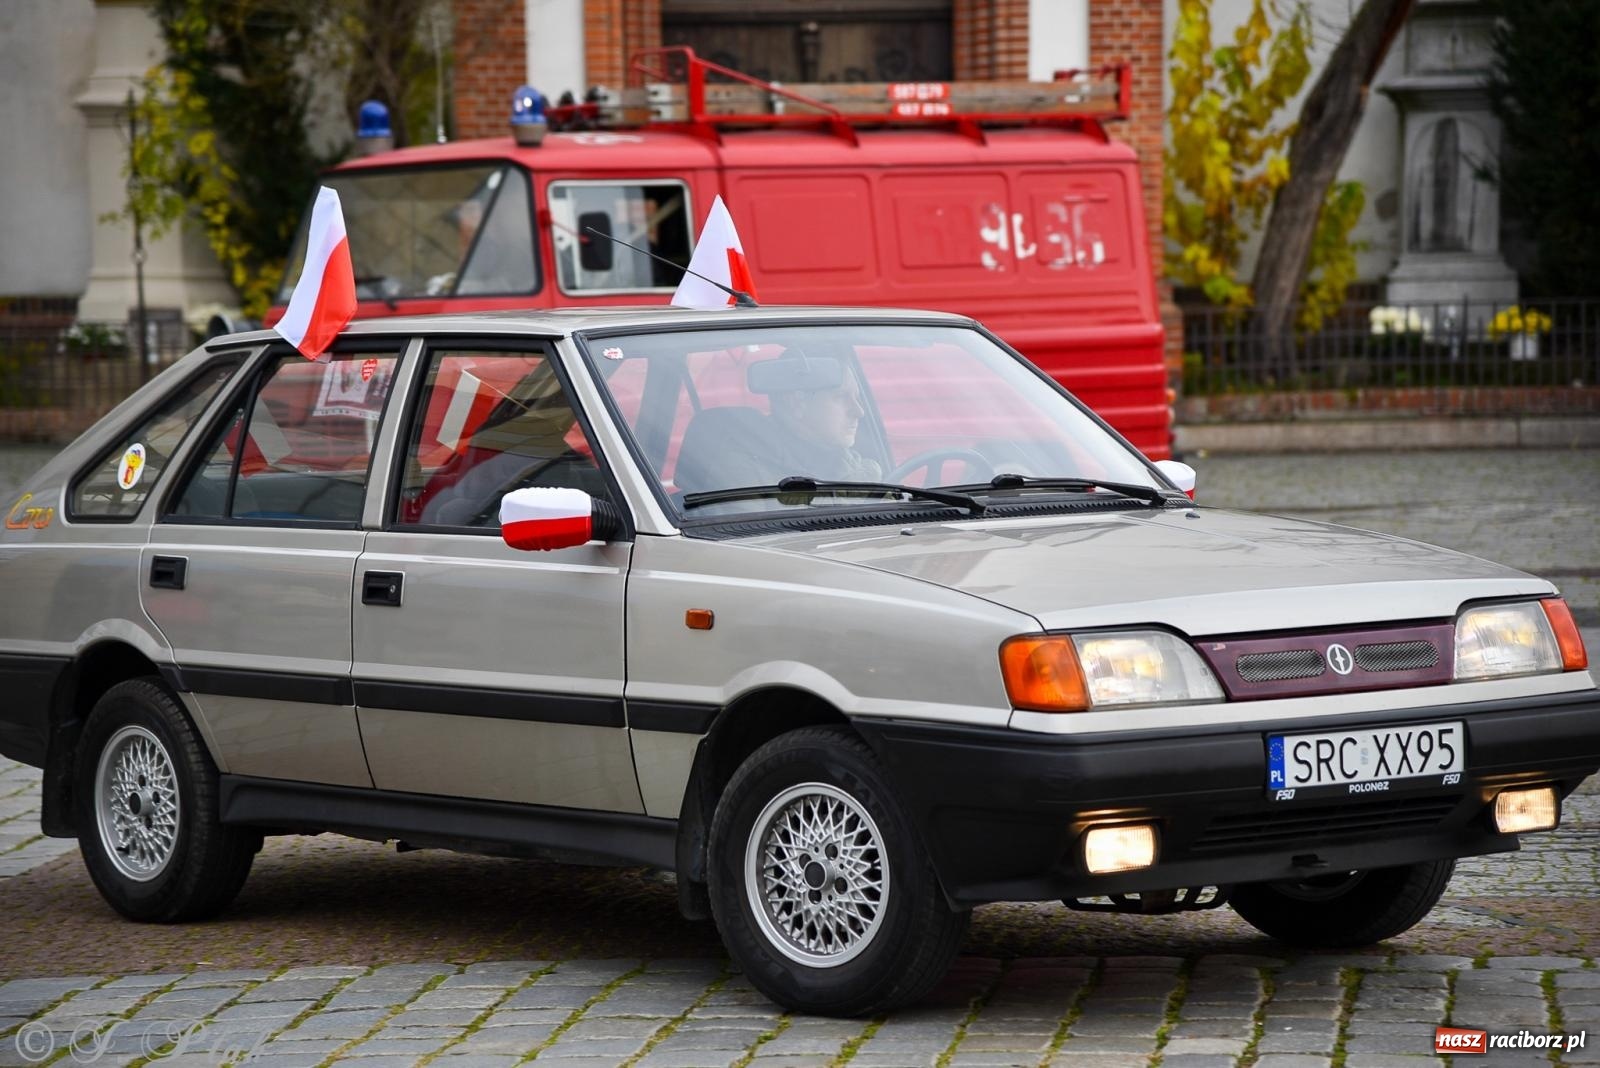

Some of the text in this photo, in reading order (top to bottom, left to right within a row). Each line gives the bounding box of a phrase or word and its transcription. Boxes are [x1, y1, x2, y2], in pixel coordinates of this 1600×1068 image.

[1293, 728, 1455, 783] SRC XX95
[1270, 770, 1284, 783] PL
